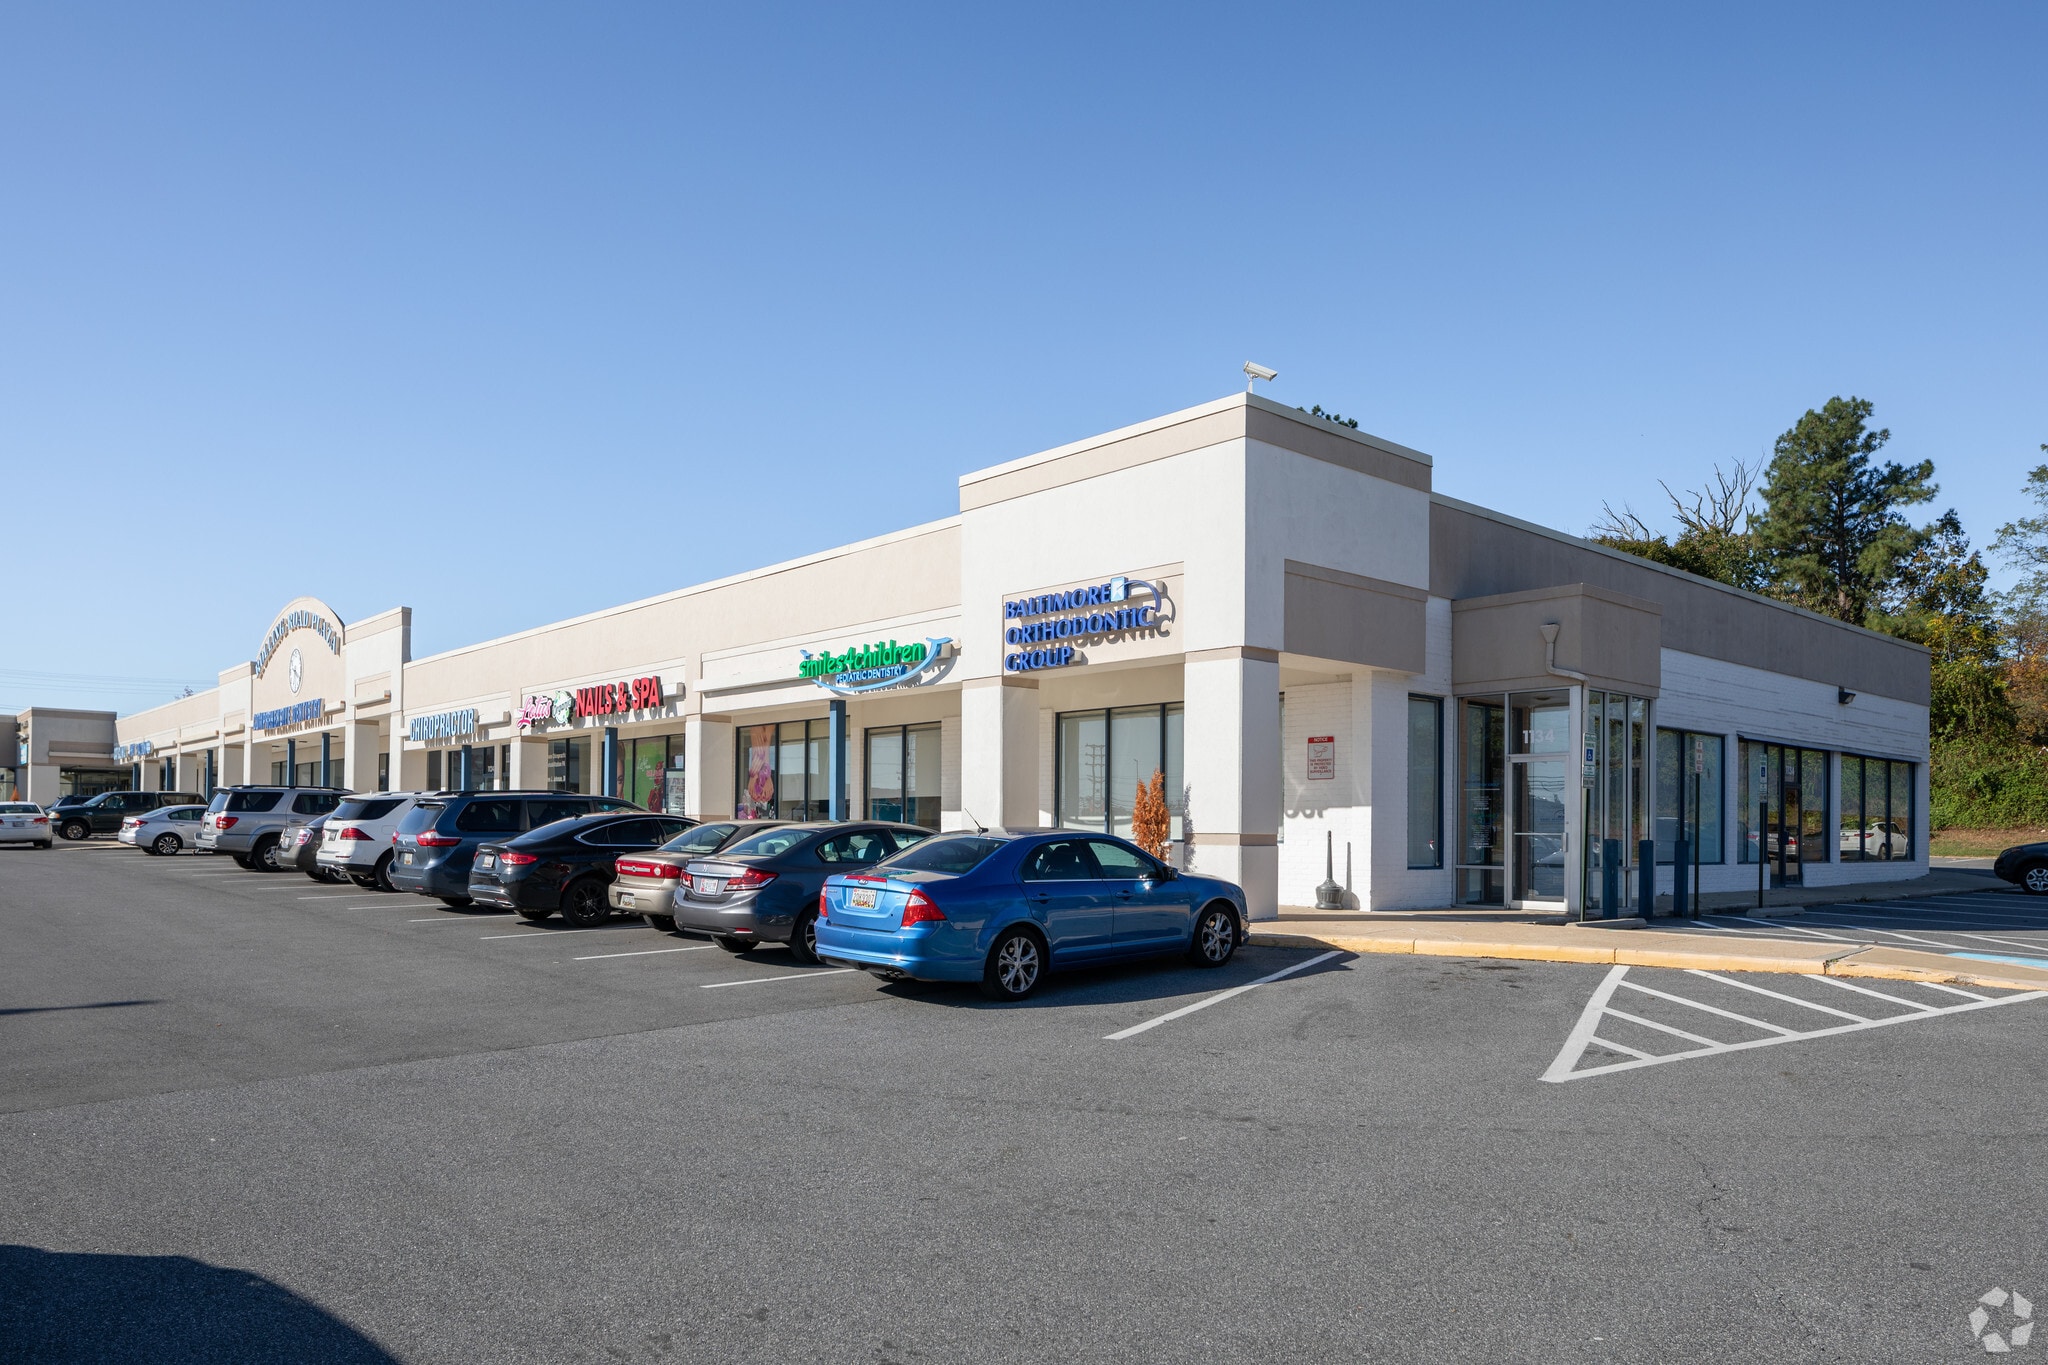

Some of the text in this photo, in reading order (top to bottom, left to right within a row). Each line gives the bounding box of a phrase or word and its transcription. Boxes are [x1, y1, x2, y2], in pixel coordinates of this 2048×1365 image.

[1005, 583, 1112, 619] BALTIMORE
[312, 612, 338, 655] PLAZA
[1005, 605, 1155, 645] ORTHODONTIC
[799, 639, 926, 678] smiles4children
[835, 665, 905, 683] PEDIATRIC DENTISTRY
[1005, 646, 1074, 672] GROUP
[576, 684, 614, 718] NAILS
[616, 682, 628, 713] &
[632, 675, 662, 710] SPA
[410, 708, 475, 742] CHIROPRACTOR
[1522, 728, 1555, 744] 1134
